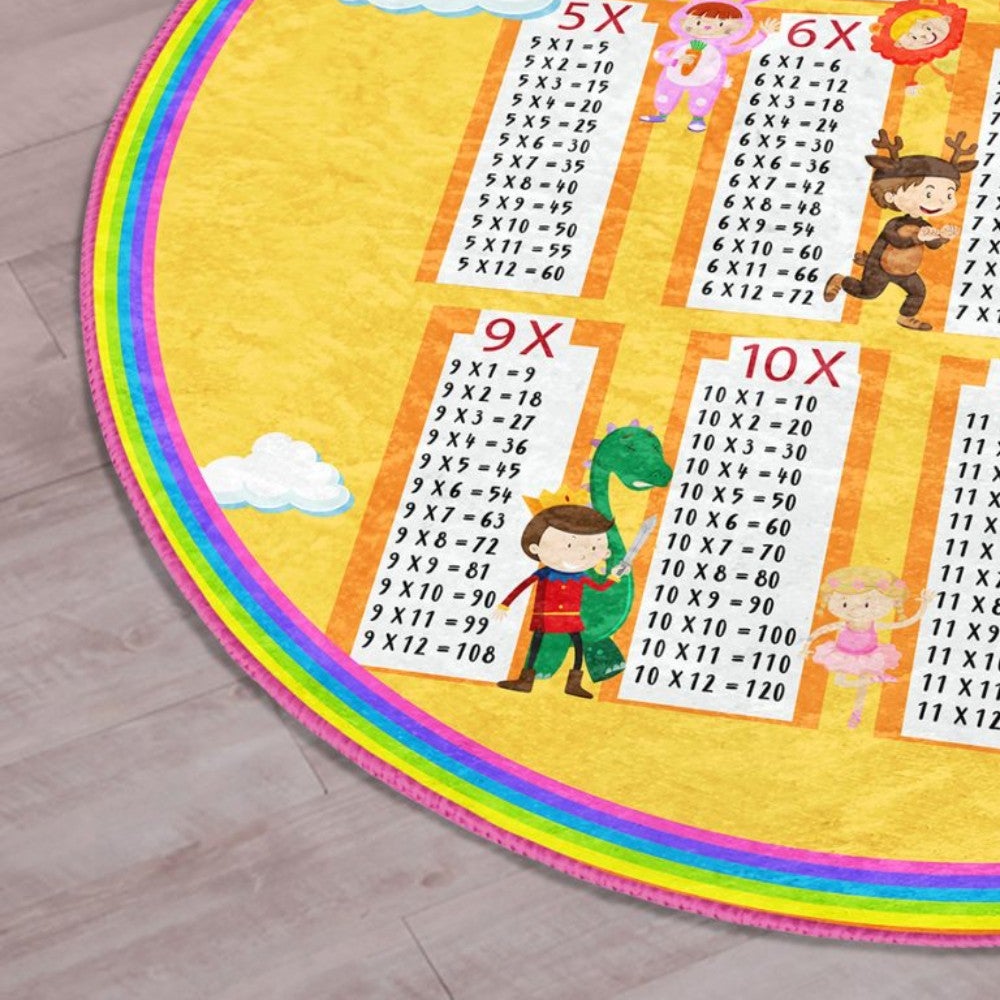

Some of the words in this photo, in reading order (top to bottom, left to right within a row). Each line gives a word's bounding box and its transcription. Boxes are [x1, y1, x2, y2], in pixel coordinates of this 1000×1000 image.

[505, 113, 516, 126] 5
[574, 119, 597, 133] 25
[987, 132, 998, 146] 7
[734, 153, 745, 167] 6
[806, 159, 830, 174] 36
[718, 215, 730, 230] 6
[793, 222, 814, 237] 54
[458, 257, 469, 271] 5
[541, 265, 565, 281] 60
[956, 305, 968, 320] 7
[963, 437, 985, 455] 11
[419, 453, 431, 469] 9
[496, 461, 521, 479] 45
[686, 457, 709, 476] 10
[778, 467, 802, 486] 40
[661, 558, 685, 578] 10
[754, 569, 780, 589] 80
[942, 564, 964, 584] 11
[362, 630, 375, 648] 9
[457, 642, 495, 664] 108
[635, 665, 659, 685] 10
[747, 679, 785, 702] 120
[918, 701, 942, 722] 11
